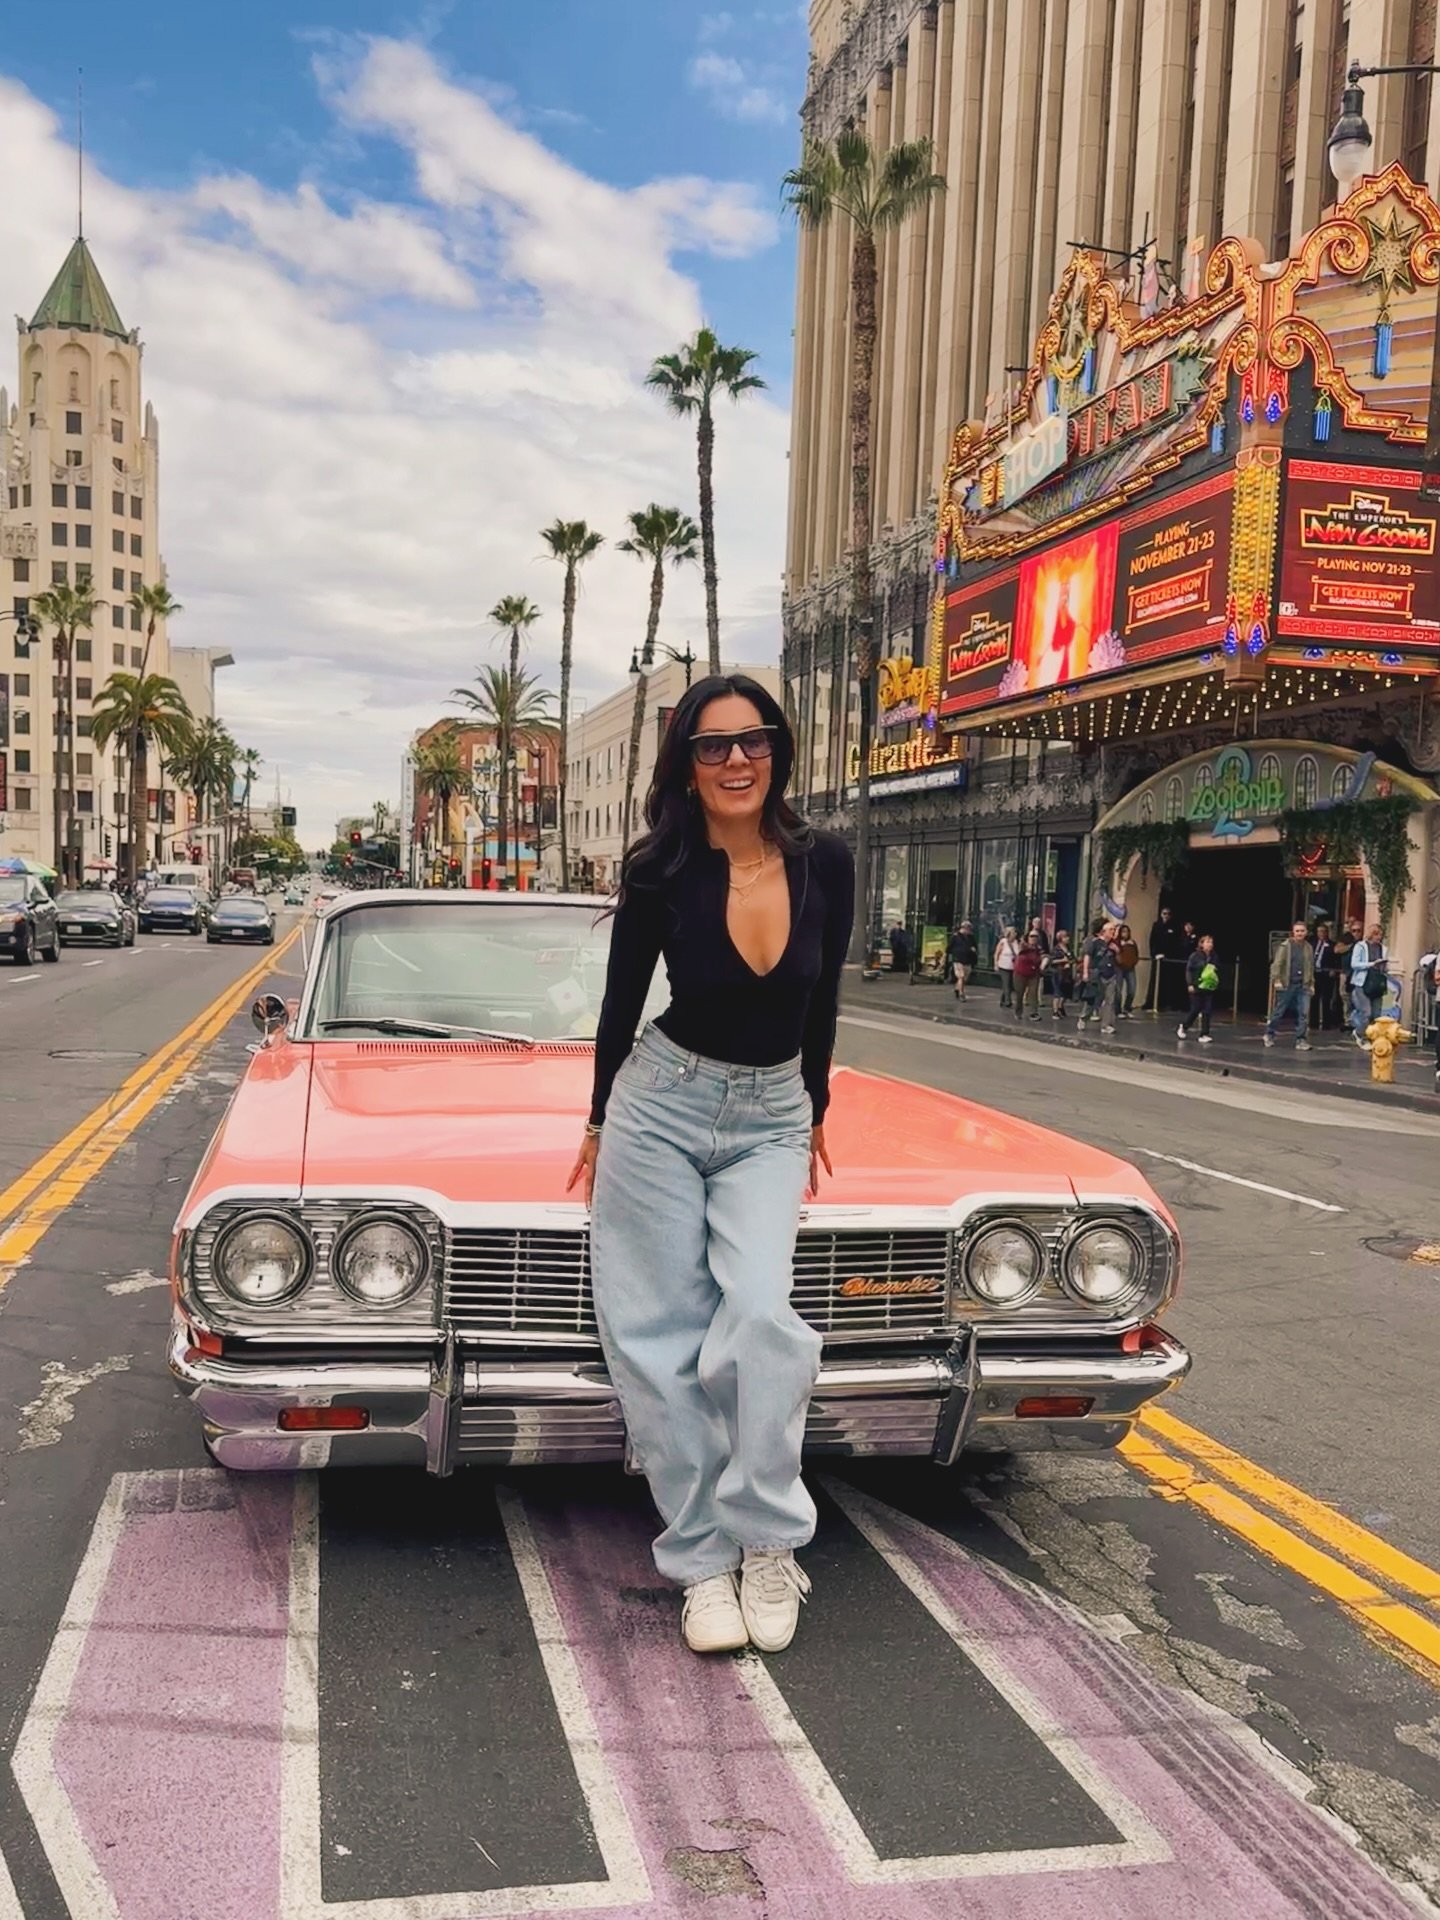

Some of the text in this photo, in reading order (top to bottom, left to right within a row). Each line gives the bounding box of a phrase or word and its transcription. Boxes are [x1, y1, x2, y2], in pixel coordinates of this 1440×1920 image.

[1356, 497, 1383, 513] Disney
[1332, 511, 1404, 525] THE EMPEROR'S
[1154, 521, 1191, 547] PLAYING
[1306, 516, 1429, 547] NEW GROOVE
[1130, 529, 1215, 576] NOVEMBER 21-23
[1317, 557, 1412, 576] PLAYING NOV 21-23
[1135, 594, 1151, 609] GET
[1150, 583, 1181, 604] TICKETS
[1181, 575, 1203, 595] NOW
[1321, 586, 1404, 602] GET TICKETS NOW
